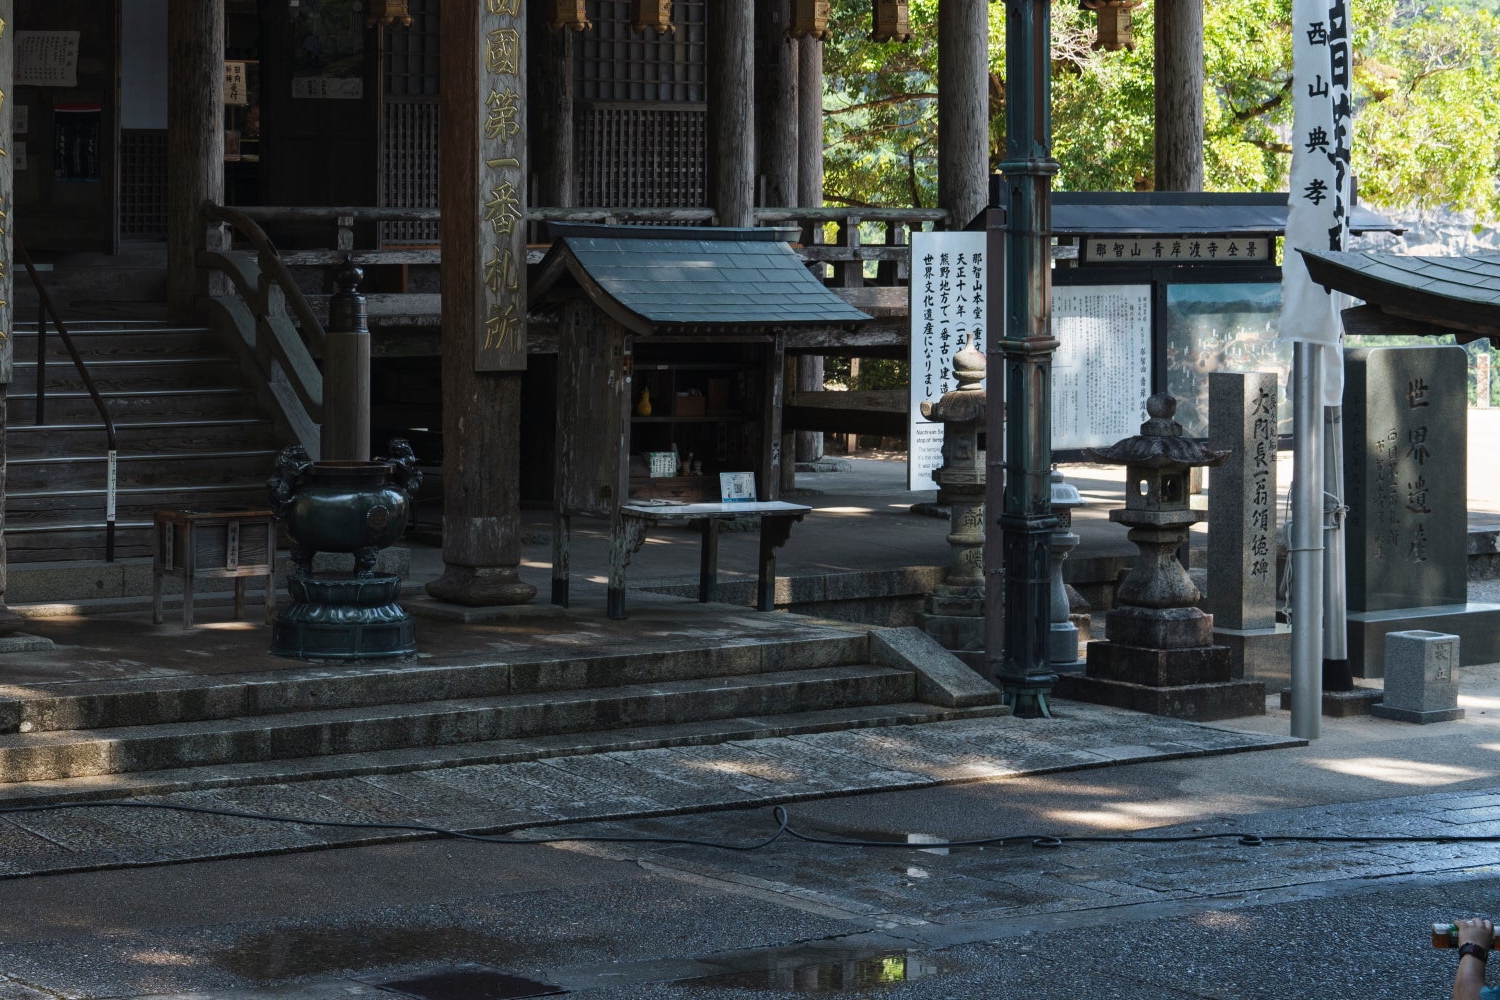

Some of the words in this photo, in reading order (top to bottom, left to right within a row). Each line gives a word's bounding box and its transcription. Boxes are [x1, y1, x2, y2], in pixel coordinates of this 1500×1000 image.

[1304, 21, 1330, 206] 西山典孝
[956, 252, 968, 352] 天正十八年（一五
[1096, 240, 1257, 258] 那智山青岸渡寺全景
[923, 253, 935, 401] 世界文化遺産になりまし
[1404, 377, 1432, 564] 世界遺産
